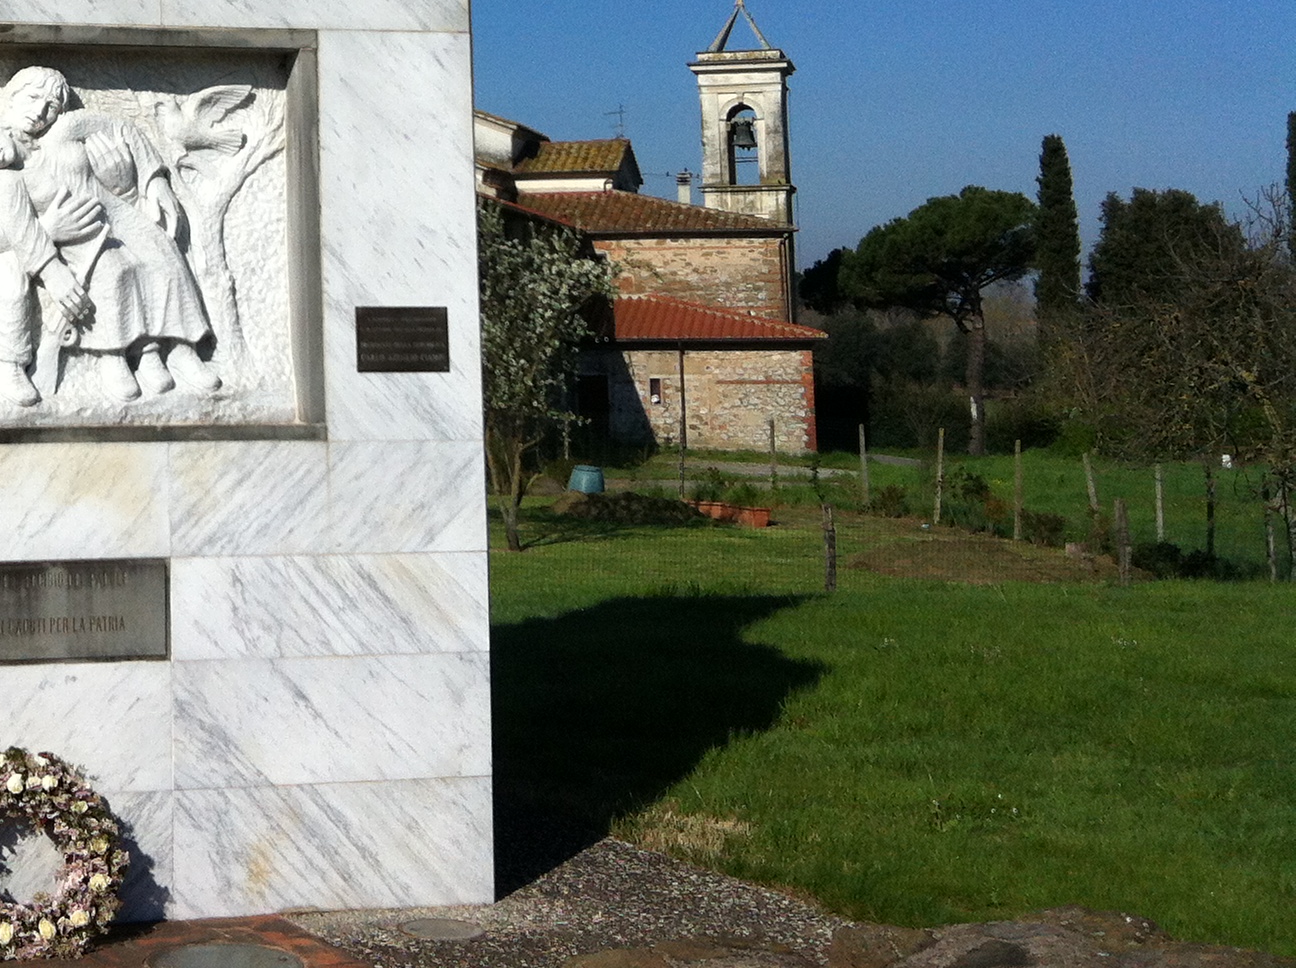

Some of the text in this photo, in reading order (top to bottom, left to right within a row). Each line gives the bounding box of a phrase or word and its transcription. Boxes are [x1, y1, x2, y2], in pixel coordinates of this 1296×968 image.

[50, 617, 68, 633] PER
[73, 616, 86, 633] LA
[89, 616, 126, 632] PATRIA
